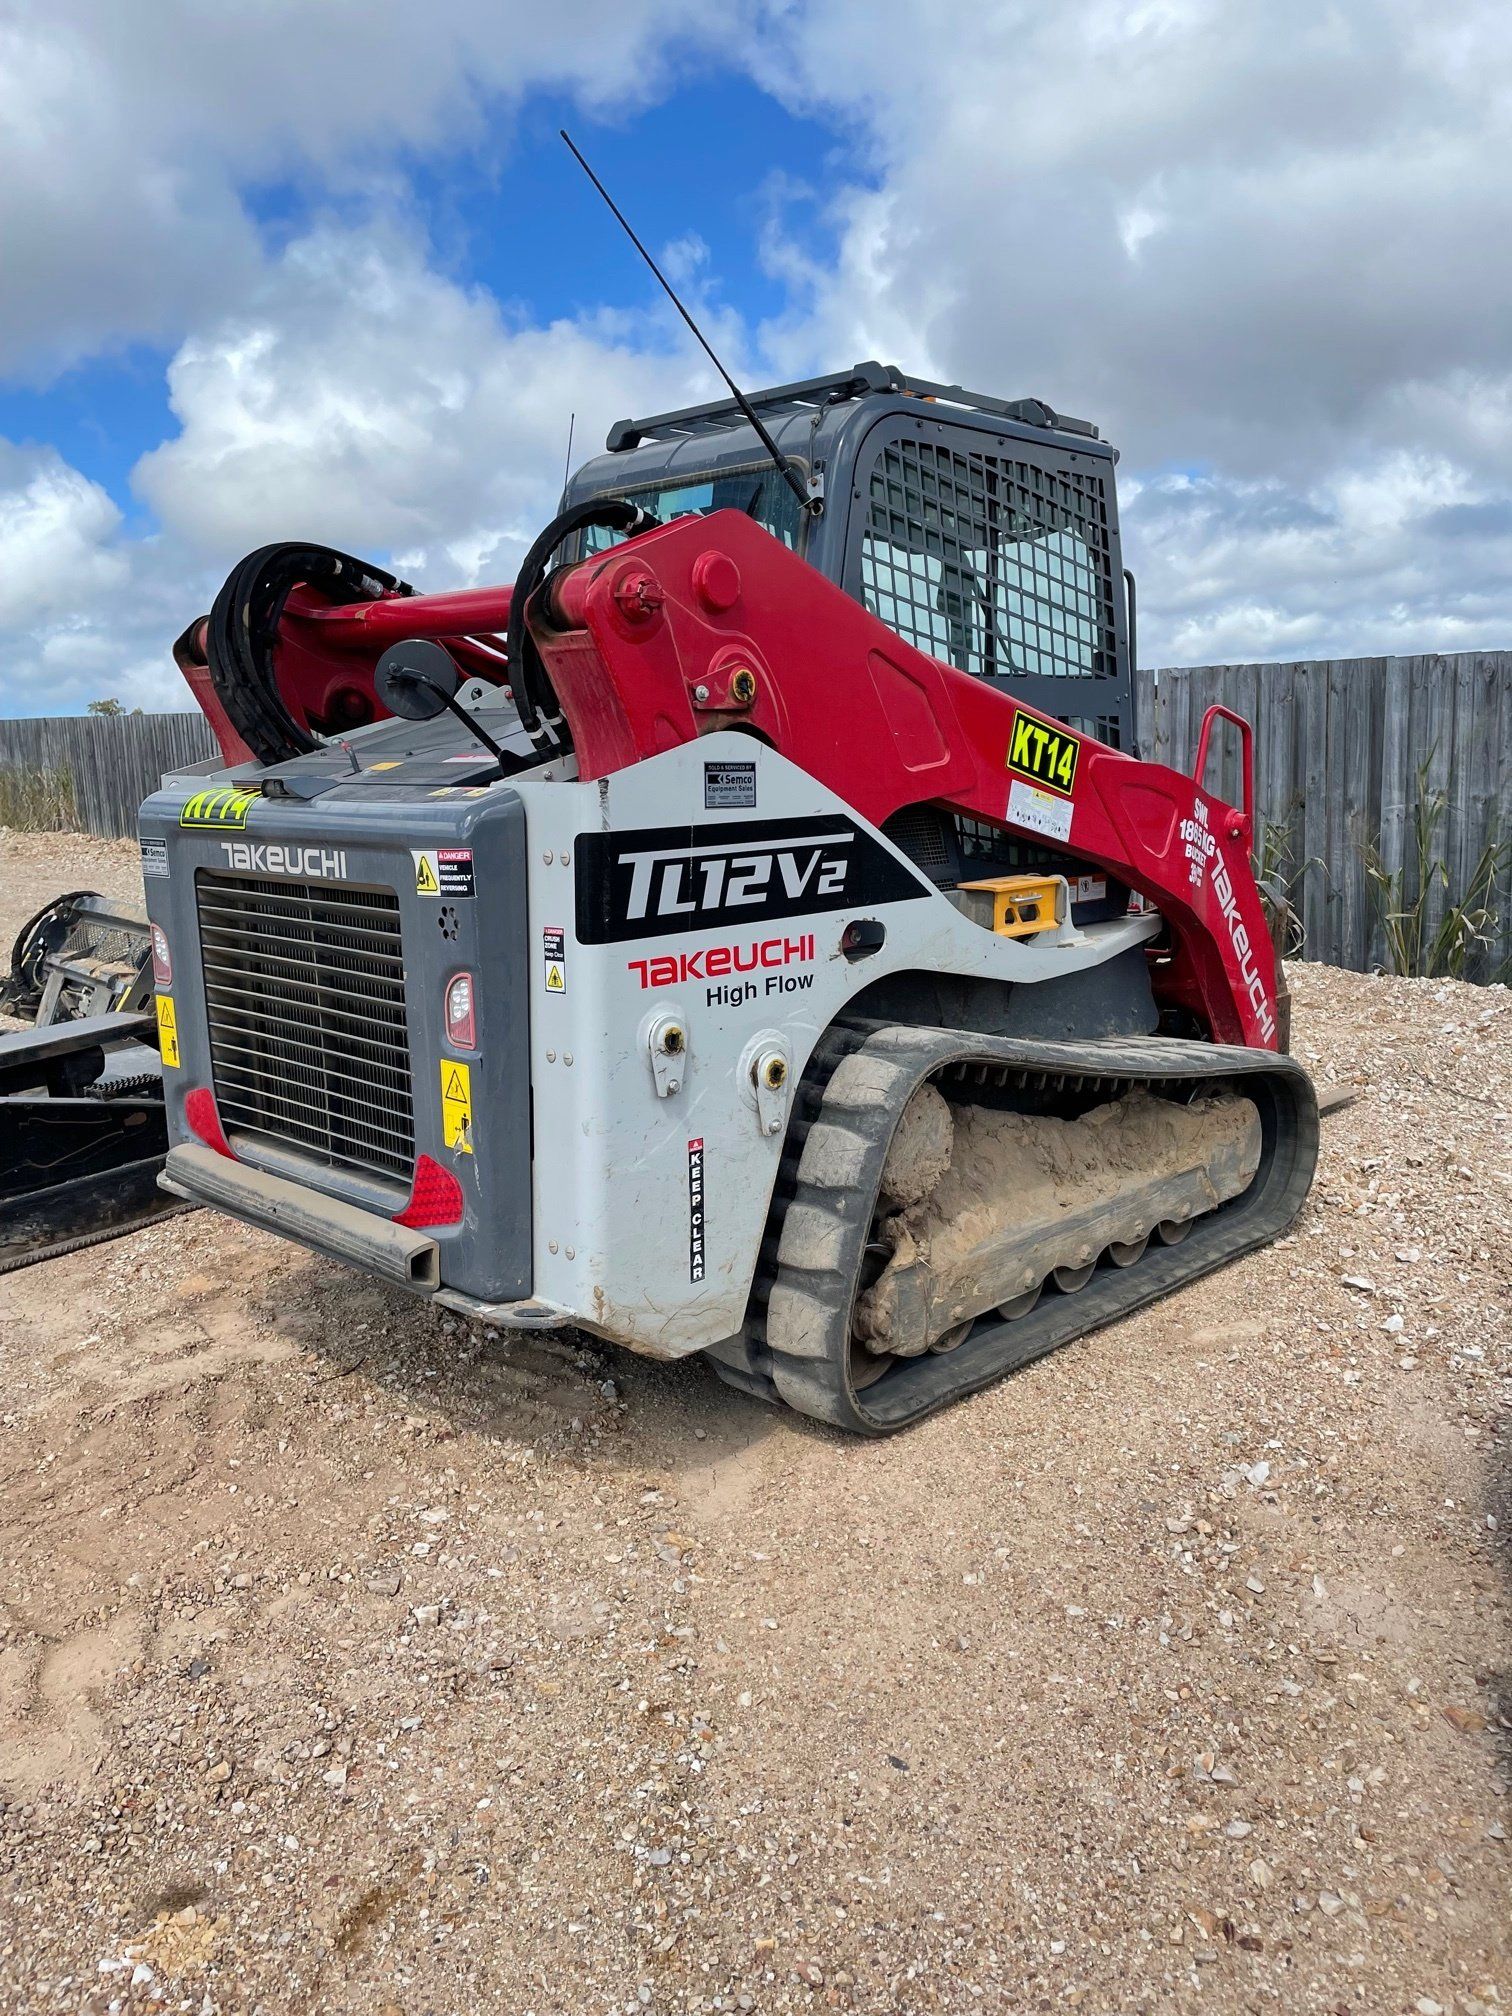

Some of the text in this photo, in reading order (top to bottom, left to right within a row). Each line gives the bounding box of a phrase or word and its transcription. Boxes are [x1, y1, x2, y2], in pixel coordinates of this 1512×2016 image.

[1012, 719, 1074, 785] KT14
[708, 785, 737, 793] Equipment
[725, 774, 752, 784] Semco
[443, 851, 470, 860] DANGER
[617, 832, 855, 920] TL12V2
[706, 974, 814, 1007] High Flow
[691, 1152, 701, 1206] KEEP
[692, 1213, 703, 1280] CLEAR
